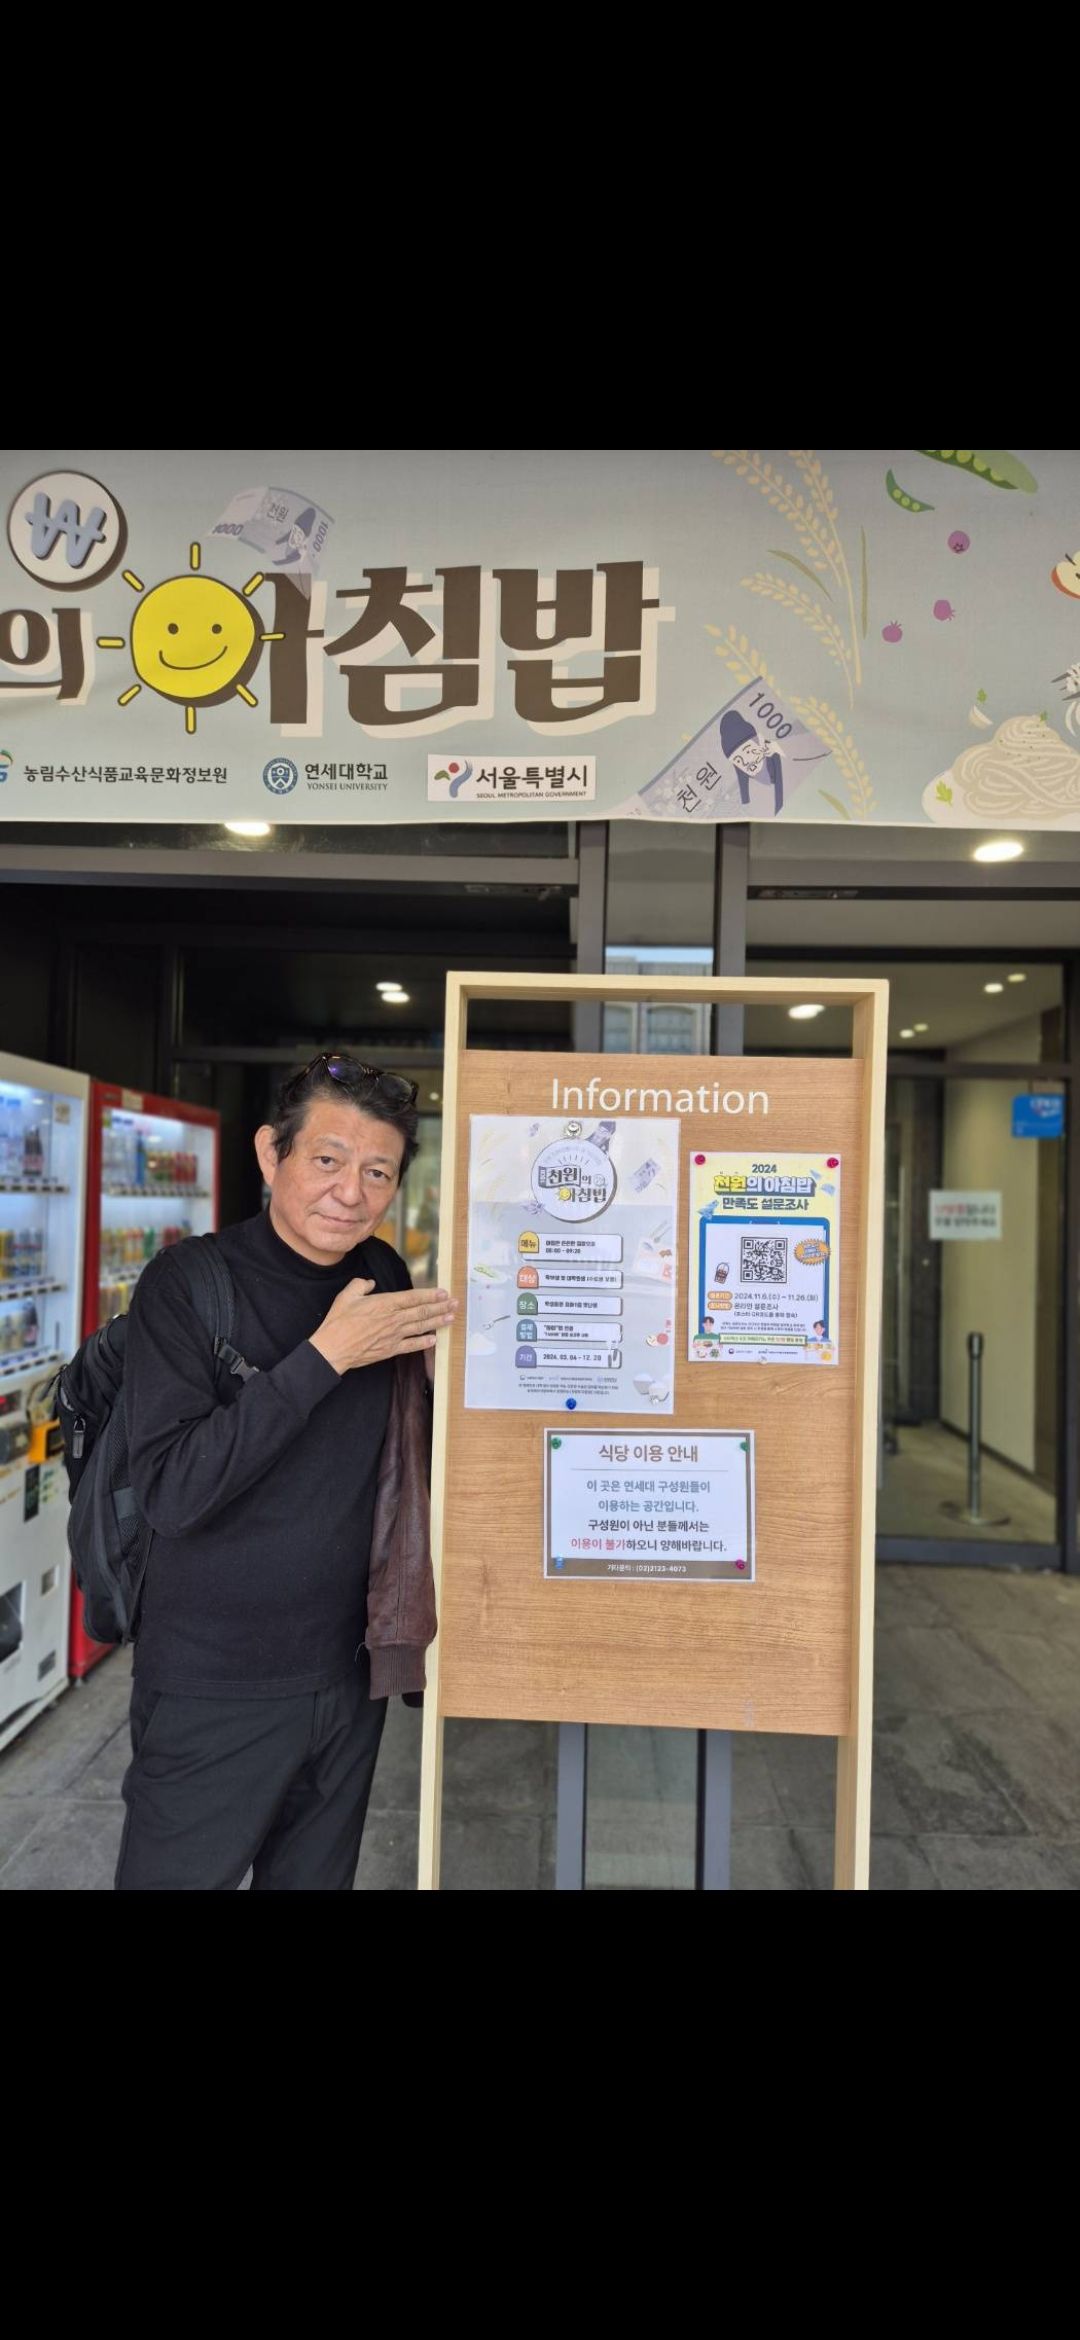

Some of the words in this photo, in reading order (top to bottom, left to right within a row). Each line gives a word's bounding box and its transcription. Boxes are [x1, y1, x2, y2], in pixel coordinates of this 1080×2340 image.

[749, 692, 792, 739] 1000
[24, 765, 228, 783] 농림수산식품교육문화정보원
[305, 763, 388, 780] 연세대학교
[476, 765, 587, 790] 서울특별시
[307, 782, 337, 791] YONSEI
[339, 782, 388, 791] UNIVERSITY
[552, 1077, 768, 1114] Information
[752, 1164, 777, 1173] 2024
[722, 1198, 758, 1210] 만족도
[761, 1198, 809, 1211] 설문조사
[520, 1301, 536, 1310] 장소
[599, 1444, 629, 1463] 식당
[633, 1444, 663, 1463] 이용
[667, 1445, 698, 1463] 안내
[587, 1480, 597, 1492] 이
[600, 1480, 621, 1493] 곳은
[624, 1480, 655, 1493] 연세대
[658, 1480, 711, 1493] 구성원들이
[598, 1500, 640, 1512] 이용하는
[643, 1500, 699, 1513] 공간입니다.
[588, 1519, 630, 1532] 구성원이
[633, 1519, 654, 1532] 아닌
[656, 1520, 710, 1532] 분들께서는
[571, 1538, 602, 1550] 이용이
[605, 1539, 657, 1551] 불가하오니
[660, 1539, 727, 1552] 양해바랍니다.
